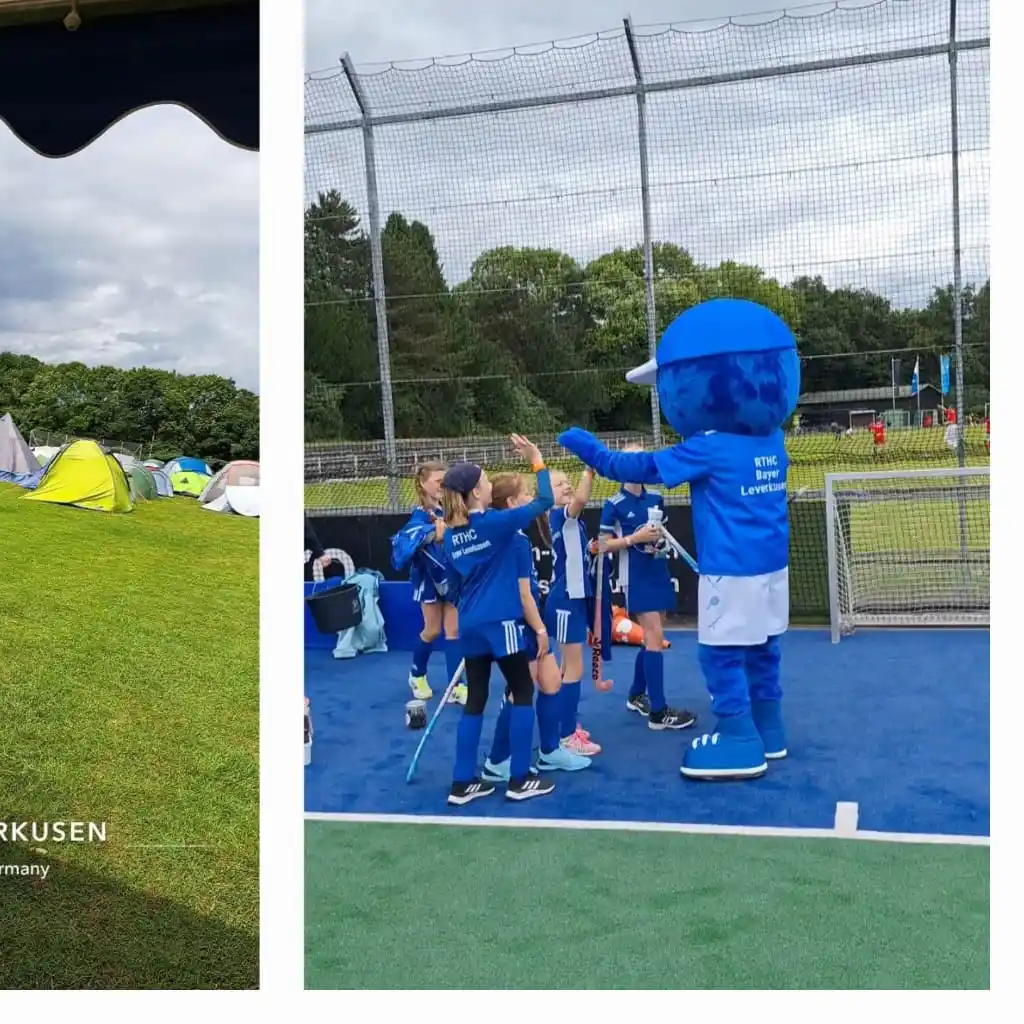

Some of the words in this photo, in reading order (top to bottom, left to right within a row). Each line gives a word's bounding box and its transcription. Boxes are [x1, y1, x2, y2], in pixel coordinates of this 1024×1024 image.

[753, 455, 778, 468] RTHC
[756, 469, 780, 481] Bayer
[451, 528, 478, 547] RTHC
